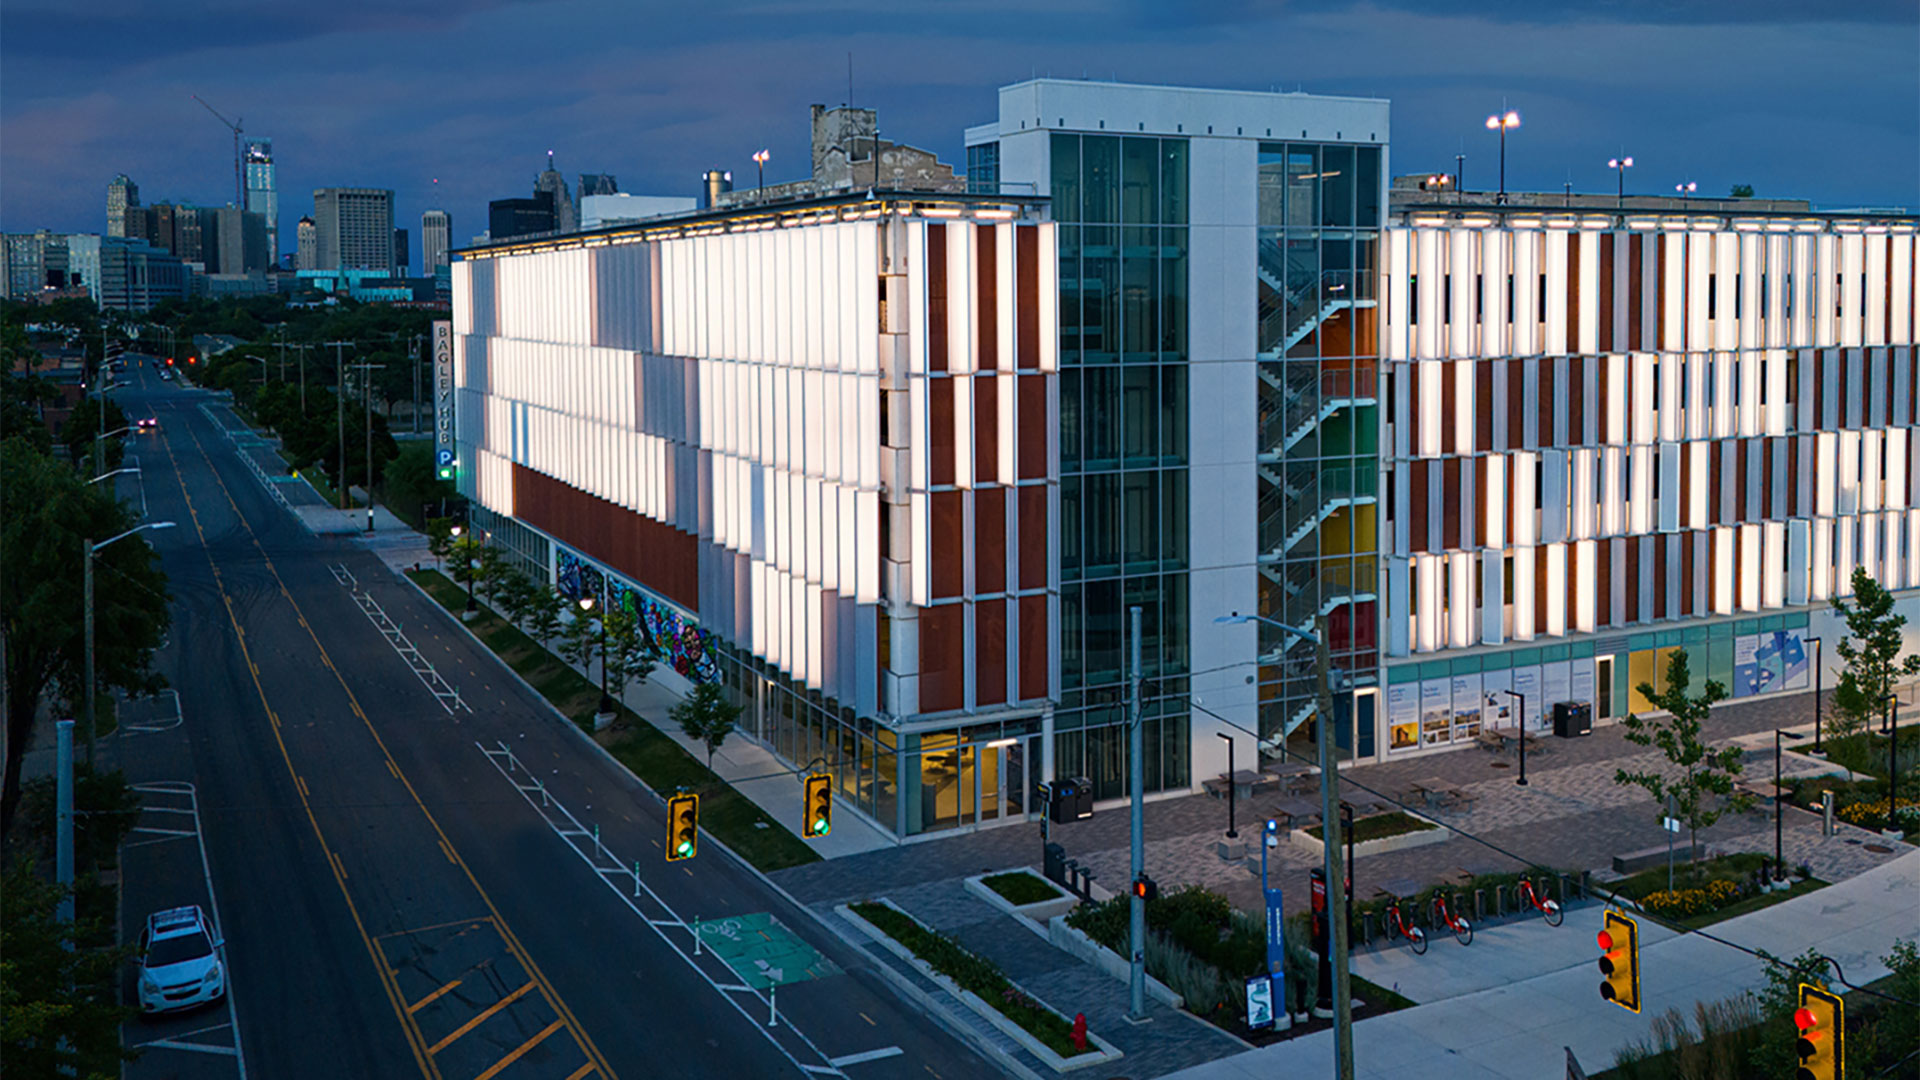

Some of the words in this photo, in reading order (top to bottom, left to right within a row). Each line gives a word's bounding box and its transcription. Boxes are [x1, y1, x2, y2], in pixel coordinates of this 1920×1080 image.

[438, 326, 449, 402] BAGLEY
[439, 408, 450, 444] HUB
[440, 453, 451, 465] P
